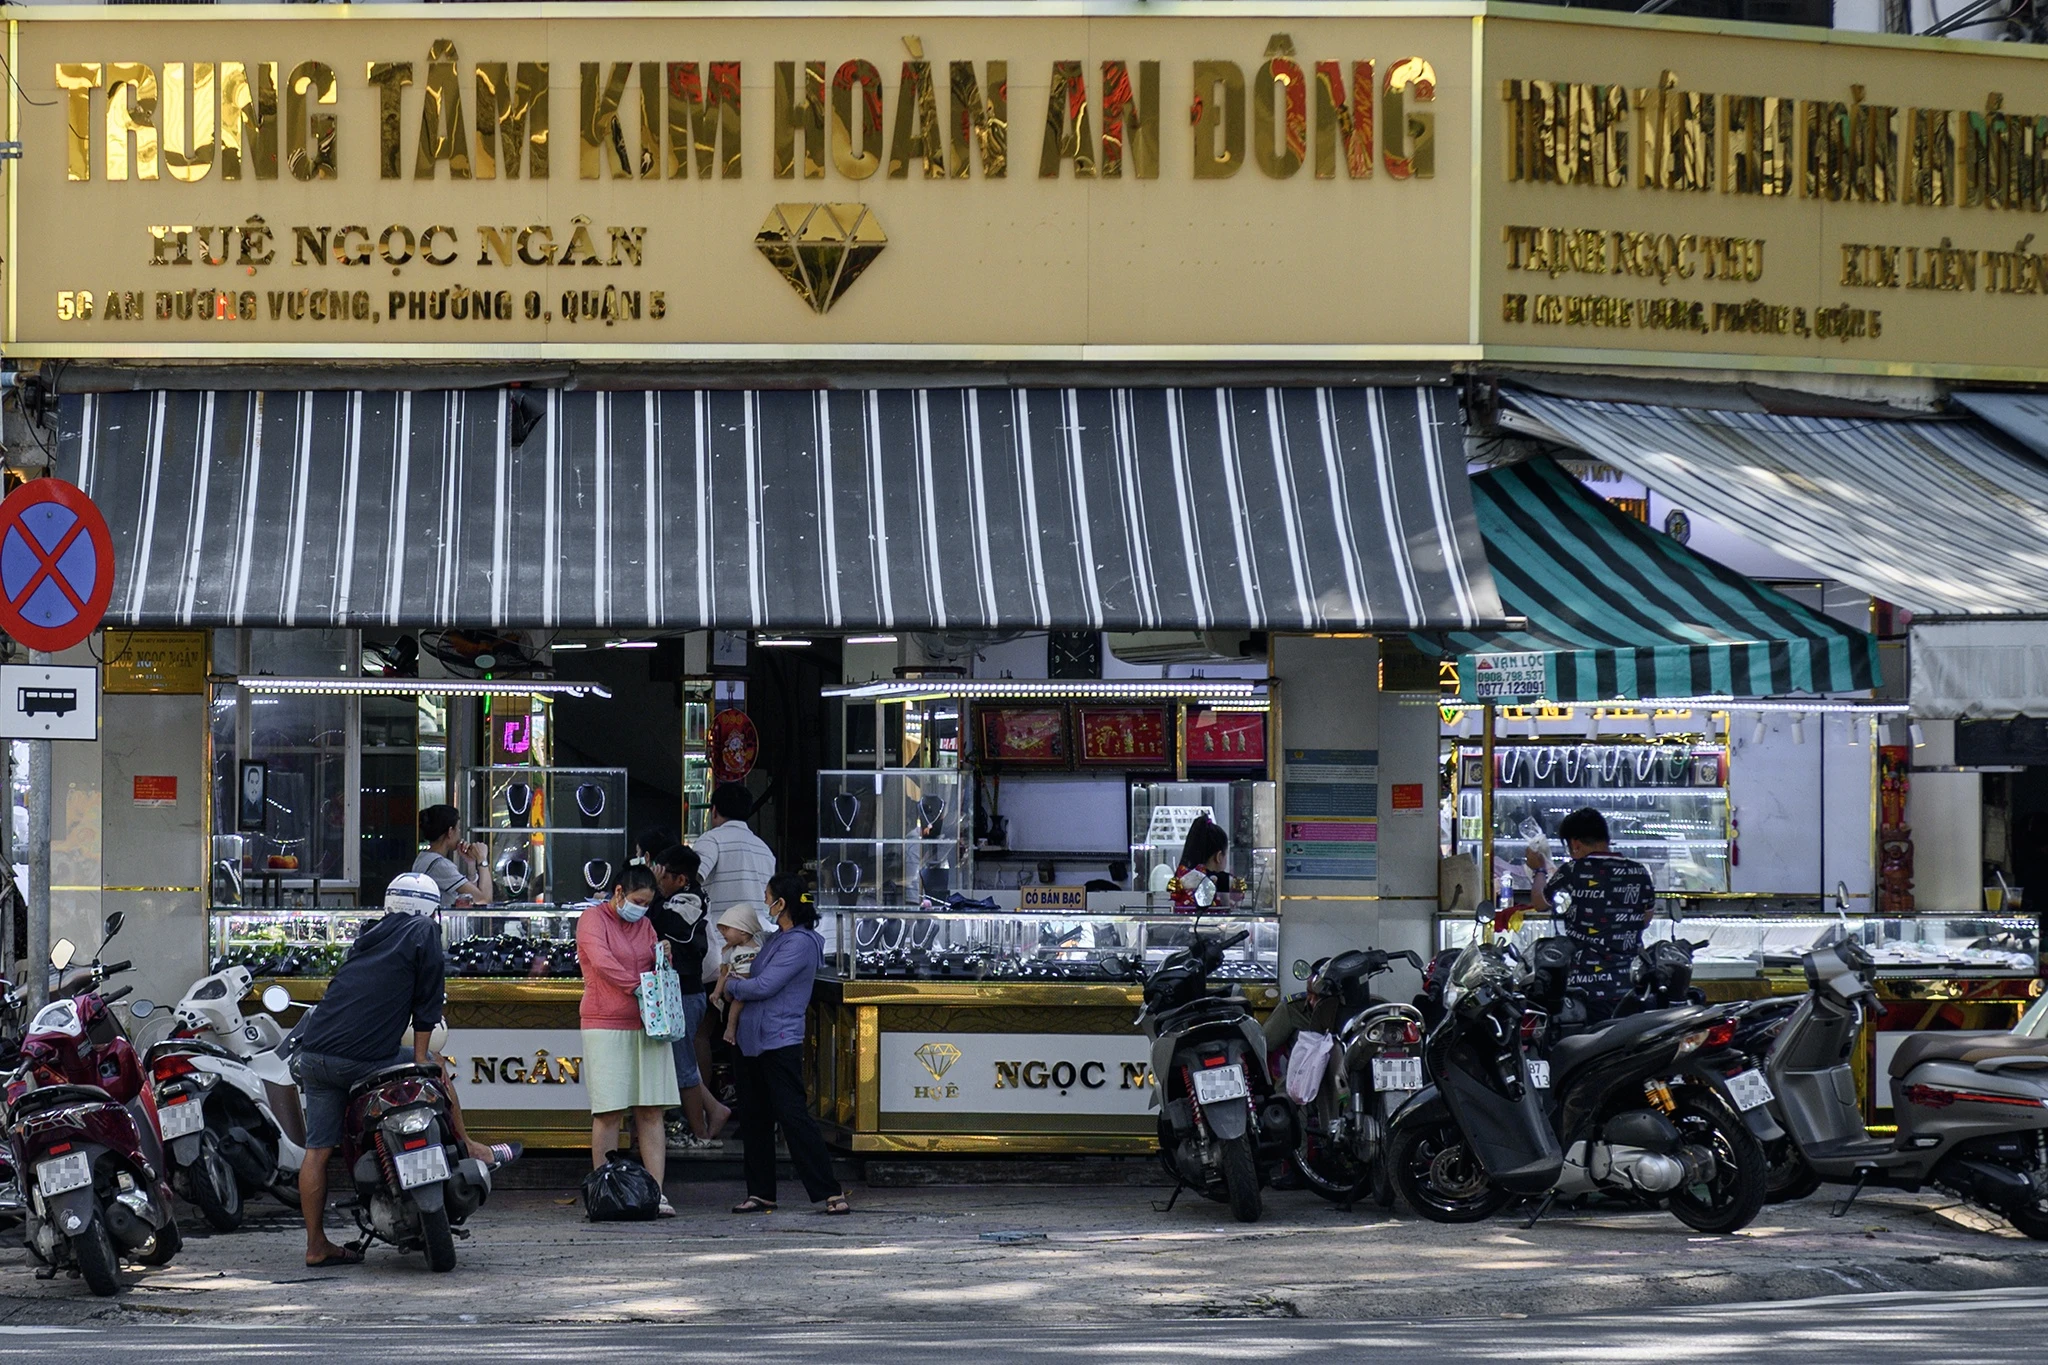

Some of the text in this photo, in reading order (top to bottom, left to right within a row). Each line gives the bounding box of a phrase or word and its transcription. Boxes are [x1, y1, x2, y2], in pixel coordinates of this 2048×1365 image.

[55, 32, 1437, 182] TRUNG TÂM KIM HOÀN AN ĐÔNG
[147, 213, 648, 277] HUỆ NGỌC NGÂN
[1502, 225, 1609, 280] THỊNH
[1610, 230, 1698, 286] NGỌC
[1840, 242, 1901, 289] KIM
[1902, 236, 1979, 292] LIÊN
[103, 290, 144, 321] AN
[155, 287, 257, 321] DƯƠNG
[267, 287, 380, 325] VƯƠNG,
[389, 283, 512, 321] PHƯỜNG
[561, 284, 641, 326] QUẬN
[649, 290, 666, 321] 5
[1477, 670, 1543, 682] 0908.798.537
[1478, 681, 1545, 695] 0977.123091
[1025, 888, 1081, 907] CÓ BÁN BẠC
[1571, 889, 1605, 899] AUTICA
[1577, 973, 1613, 983] NAUTICA
[471, 1048, 583, 1084] NGÂN
[994, 1061, 1154, 1096] NGỌC N
